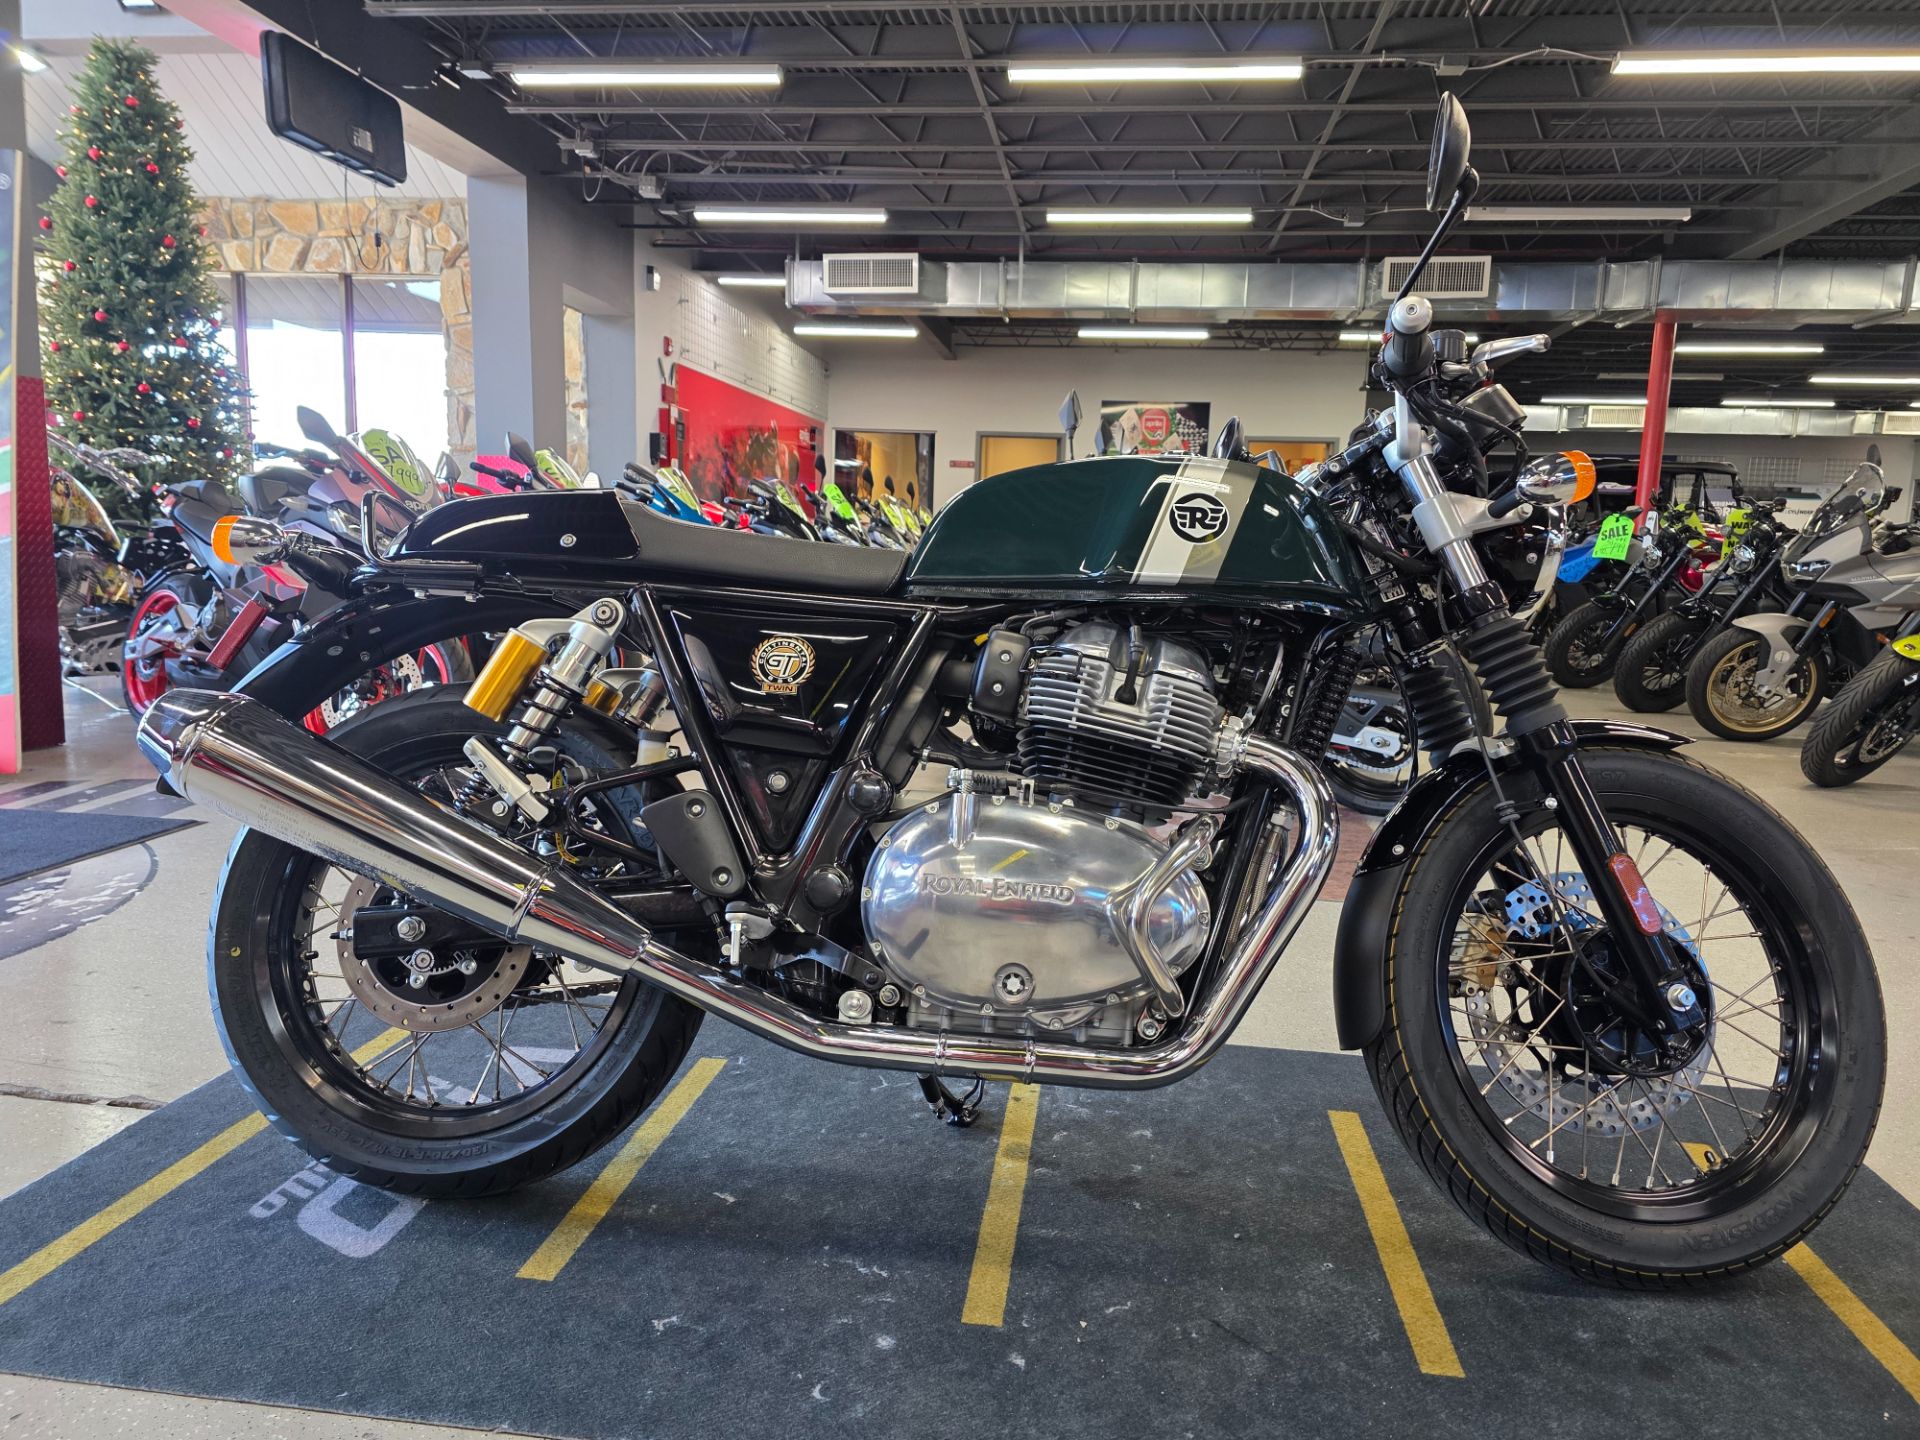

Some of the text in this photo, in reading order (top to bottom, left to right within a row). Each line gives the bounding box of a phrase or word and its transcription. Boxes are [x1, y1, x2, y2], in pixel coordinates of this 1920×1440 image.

[1601, 525, 1629, 541] SALE
[759, 641, 807, 668] CONTINENTAL
[767, 684, 794, 692] TWIN
[990, 877, 1076, 905] ENFIELD
